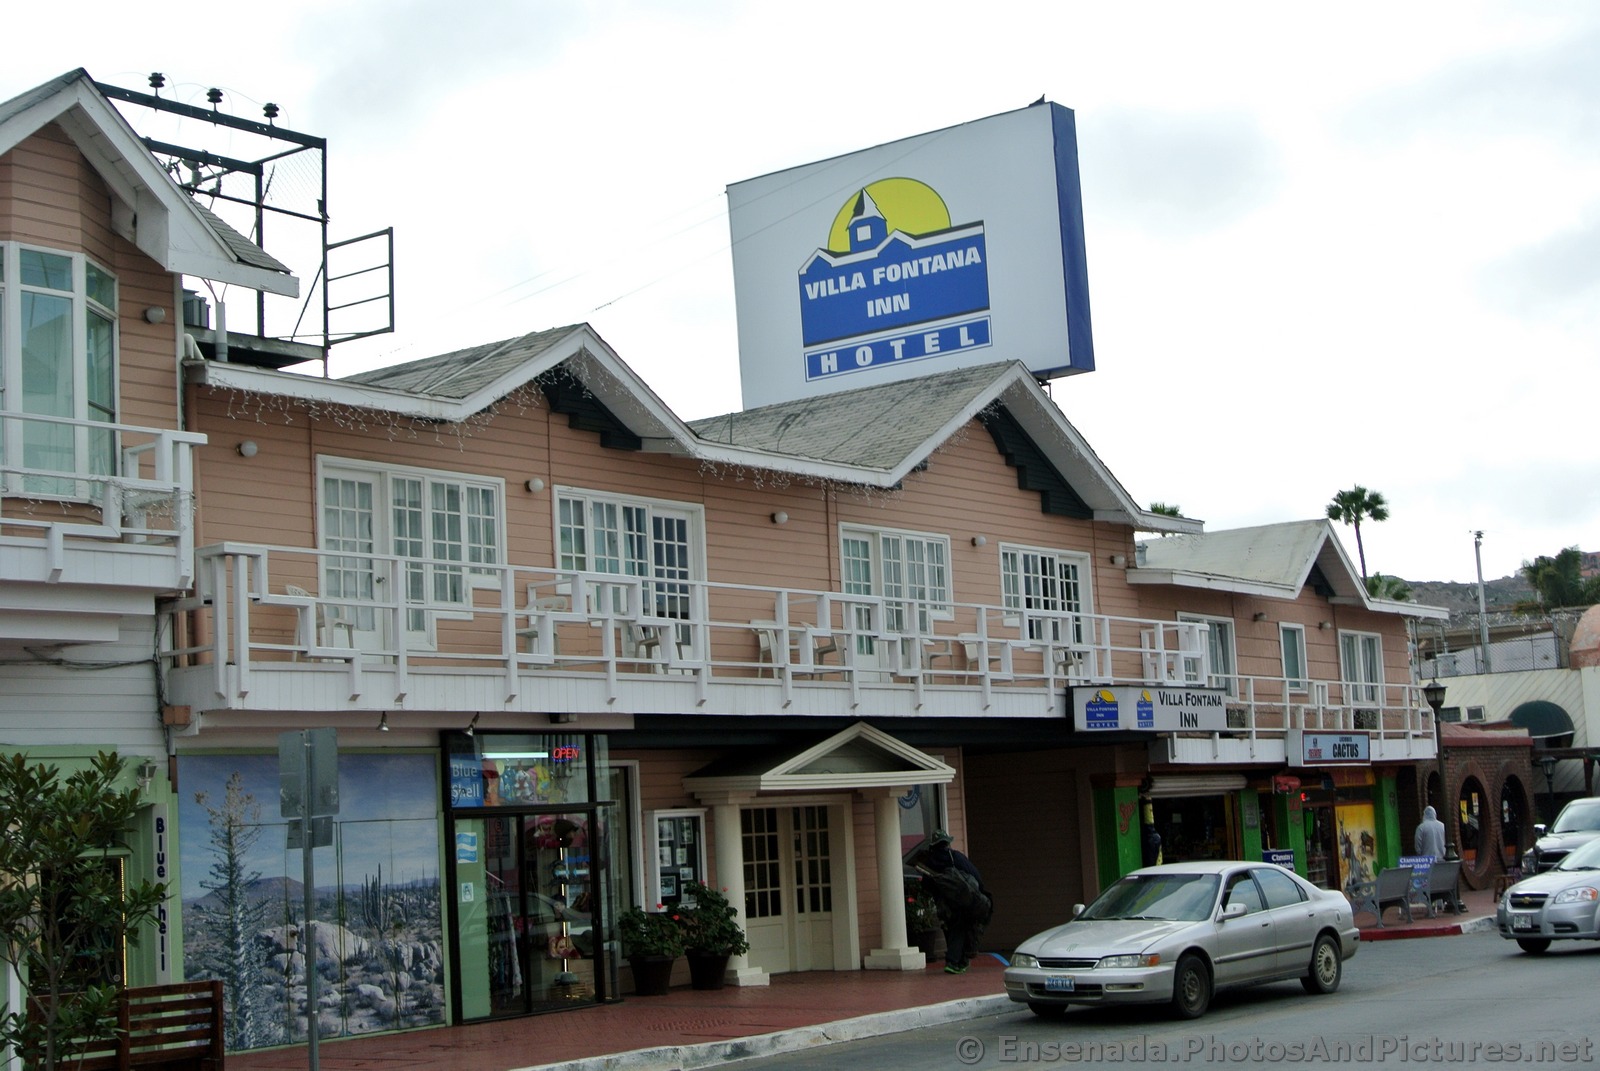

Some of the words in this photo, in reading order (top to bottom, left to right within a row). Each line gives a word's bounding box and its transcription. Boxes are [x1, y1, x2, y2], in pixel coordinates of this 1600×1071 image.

[805, 272, 866, 300] VILLA
[873, 247, 982, 286] FONTANA
[867, 293, 910, 318] INN
[820, 326, 975, 374] HOTEL
[1158, 691, 1183, 706] VILLA
[1185, 693, 1222, 707] FONTANA
[1180, 711, 1198, 728] INN
[552, 748, 579, 759] OPEN
[1332, 743, 1359, 758] CACTUS
[452, 764, 477, 777] Blue
[452, 784, 480, 798] Shell
[155, 817, 165, 878] Blue
